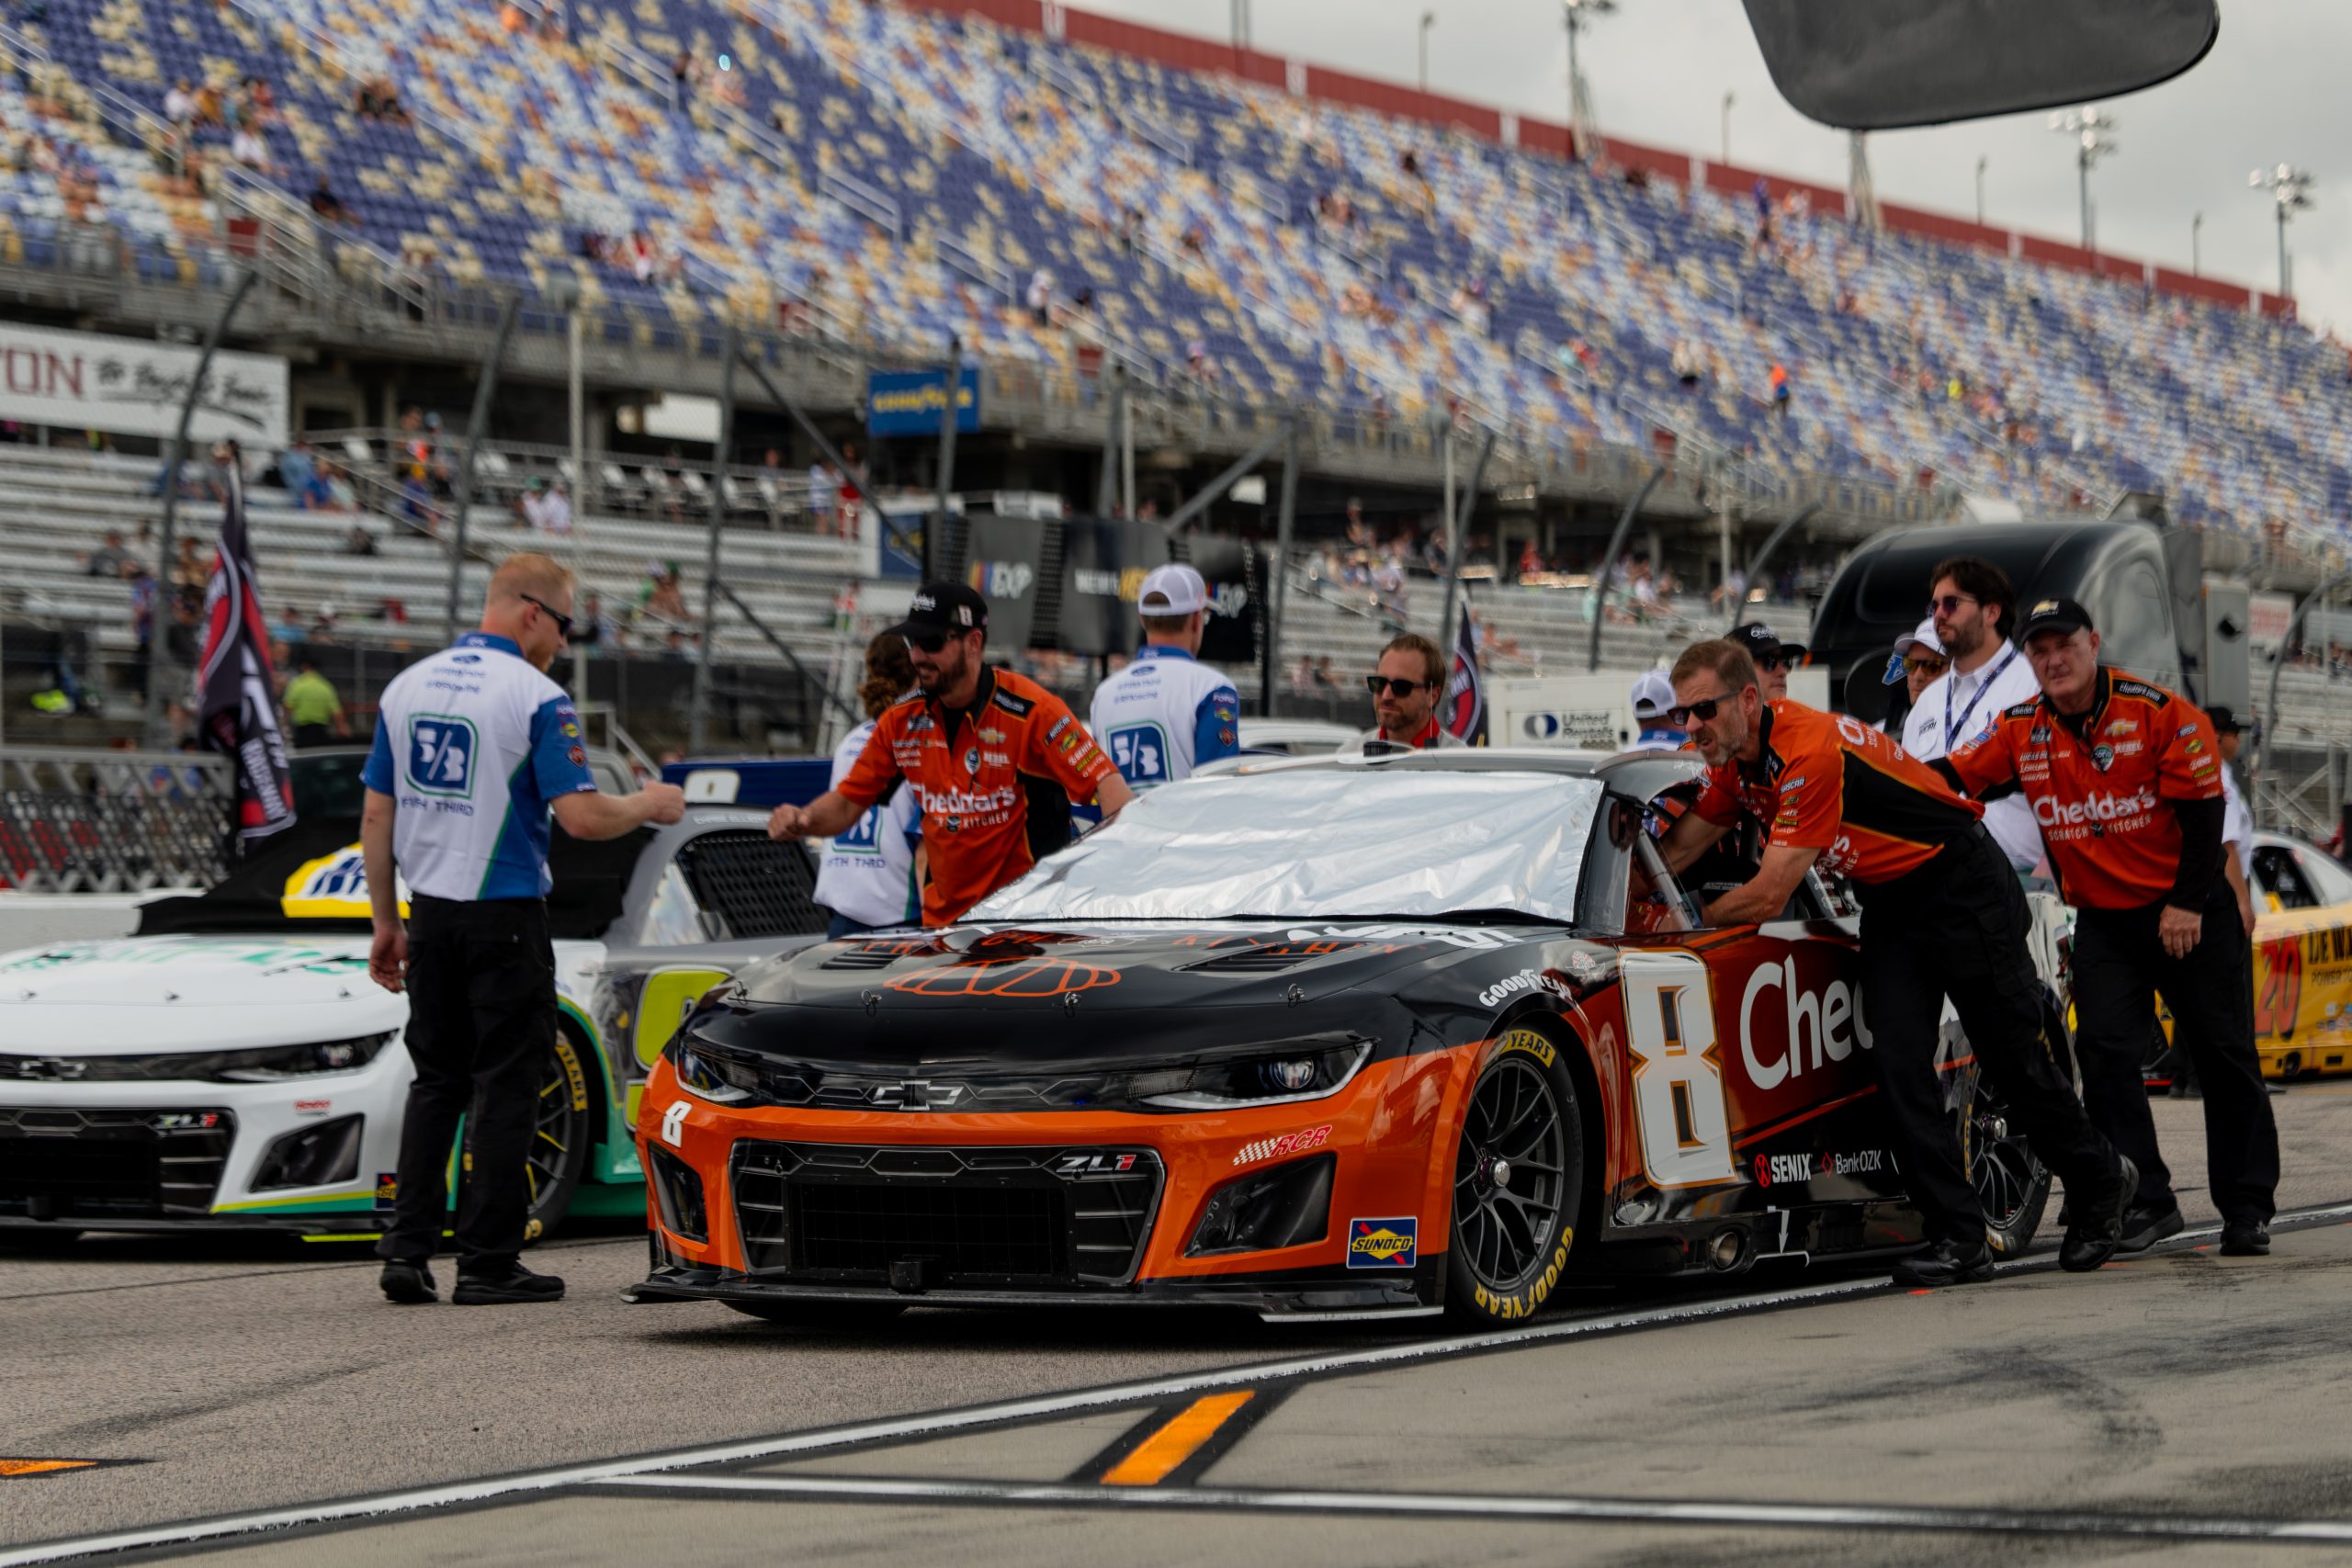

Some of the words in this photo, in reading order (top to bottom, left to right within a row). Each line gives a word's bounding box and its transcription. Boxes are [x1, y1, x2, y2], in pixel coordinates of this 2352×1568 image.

[0, 345, 85, 398] ON
[1563, 712, 1610, 727] United
[1563, 727, 1614, 739] Rentals
[910, 783, 1016, 814] heddar's
[1781, 775, 1804, 794] NASCAR
[963, 809, 1010, 829] KITCHEN
[2033, 784, 2156, 826] Cheddar's
[2048, 826, 2089, 841] SCRATCH
[1478, 968, 1574, 1008] GOODYEAR
[2254, 930, 2301, 1041] 20
[1510, 1032, 1552, 1060] YEARS
[1619, 949, 1736, 1188] 8
[661, 1100, 693, 1148] 8
[1270, 1125, 1332, 1156] RCR
[1056, 1154, 1137, 1173] ZL1
[1770, 1153, 1812, 1184] SENIX
[1352, 1235, 1413, 1253] SUNOCO
[1475, 1225, 1574, 1319] GOODYEAR
